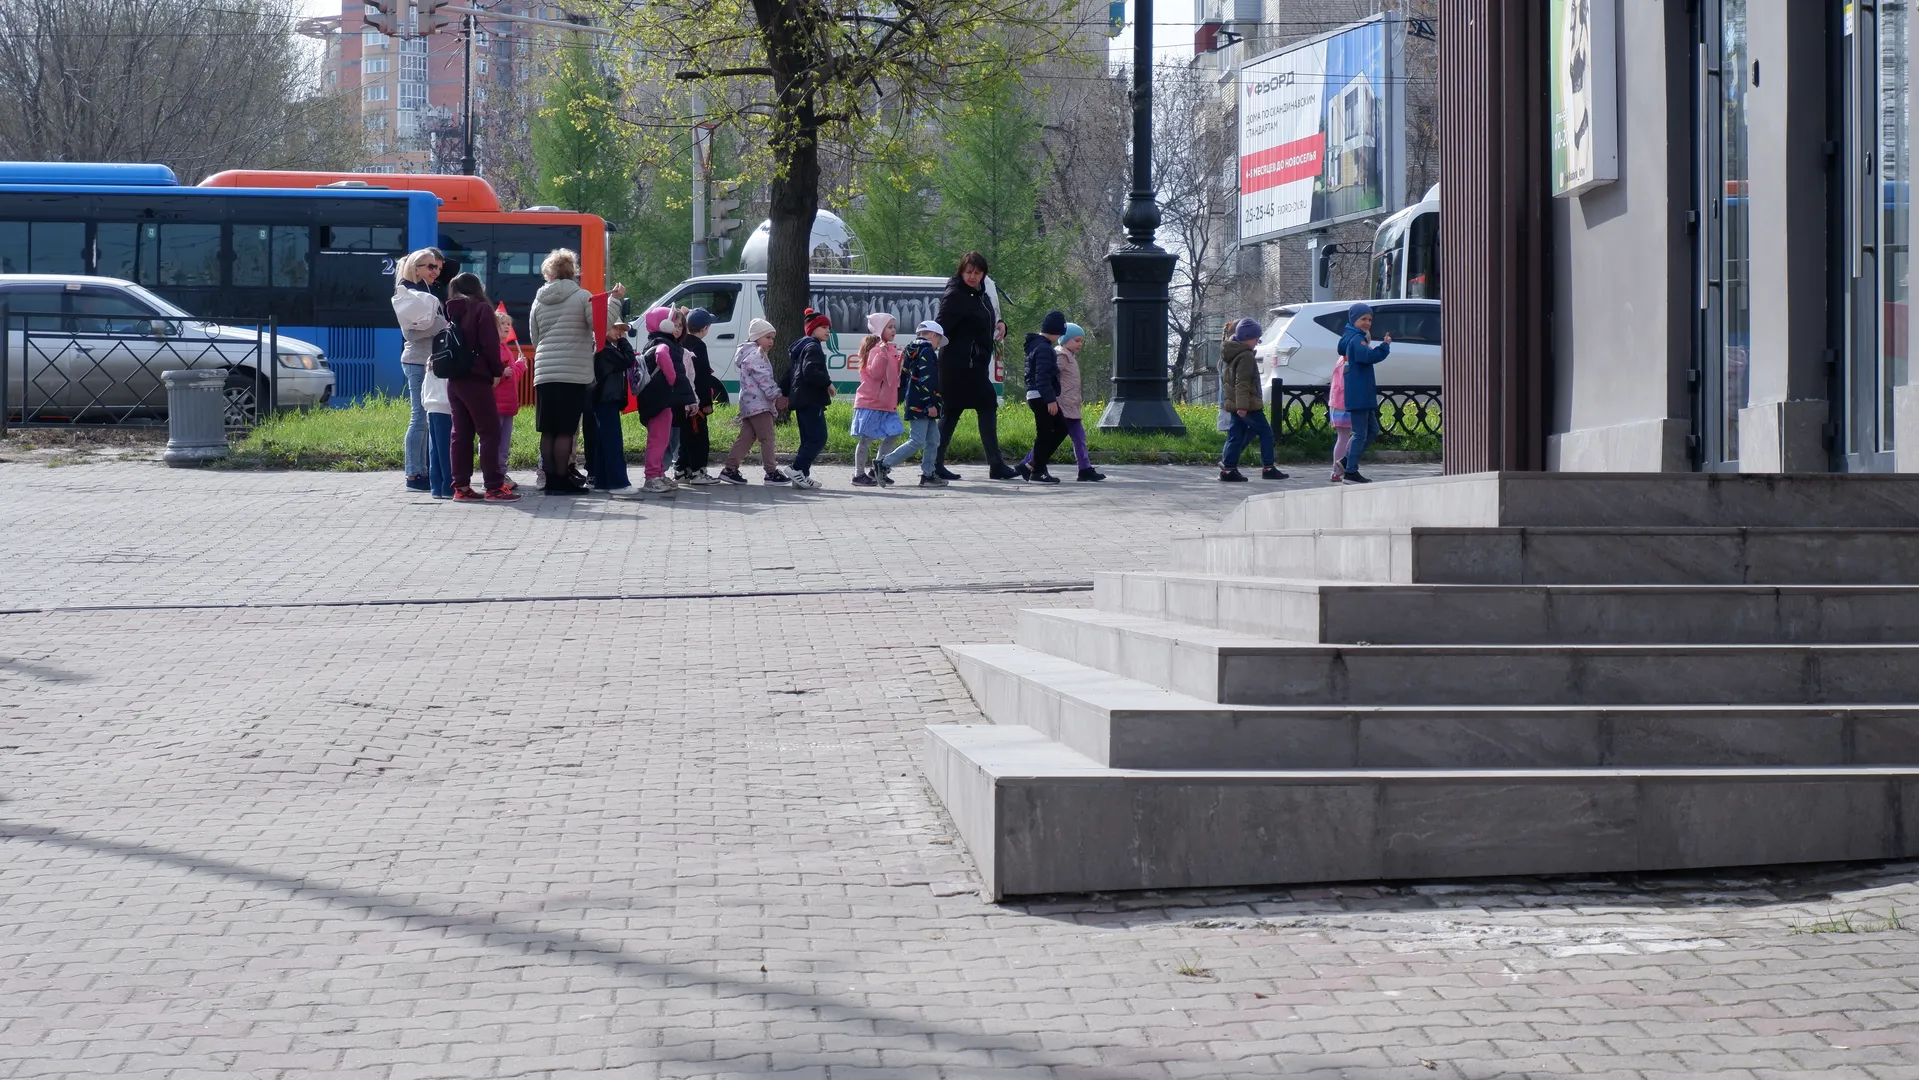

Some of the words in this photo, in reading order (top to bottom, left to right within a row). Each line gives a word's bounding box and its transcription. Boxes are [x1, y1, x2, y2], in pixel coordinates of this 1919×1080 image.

[1246, 112, 1260, 127] ДОМА
[1262, 109, 1269, 120] ПО
[1269, 94, 1316, 117] СКАНДИНАВСКИМ
[1246, 120, 1278, 138] СТАНДАРТАМ
[1253, 162, 1276, 177] МЕСЯЦЕВ
[1276, 159, 1285, 172] ДО
[1285, 150, 1317, 168] НОВОСЕЛЬЯ
[1245, 203, 1275, 223] 25-25-45
